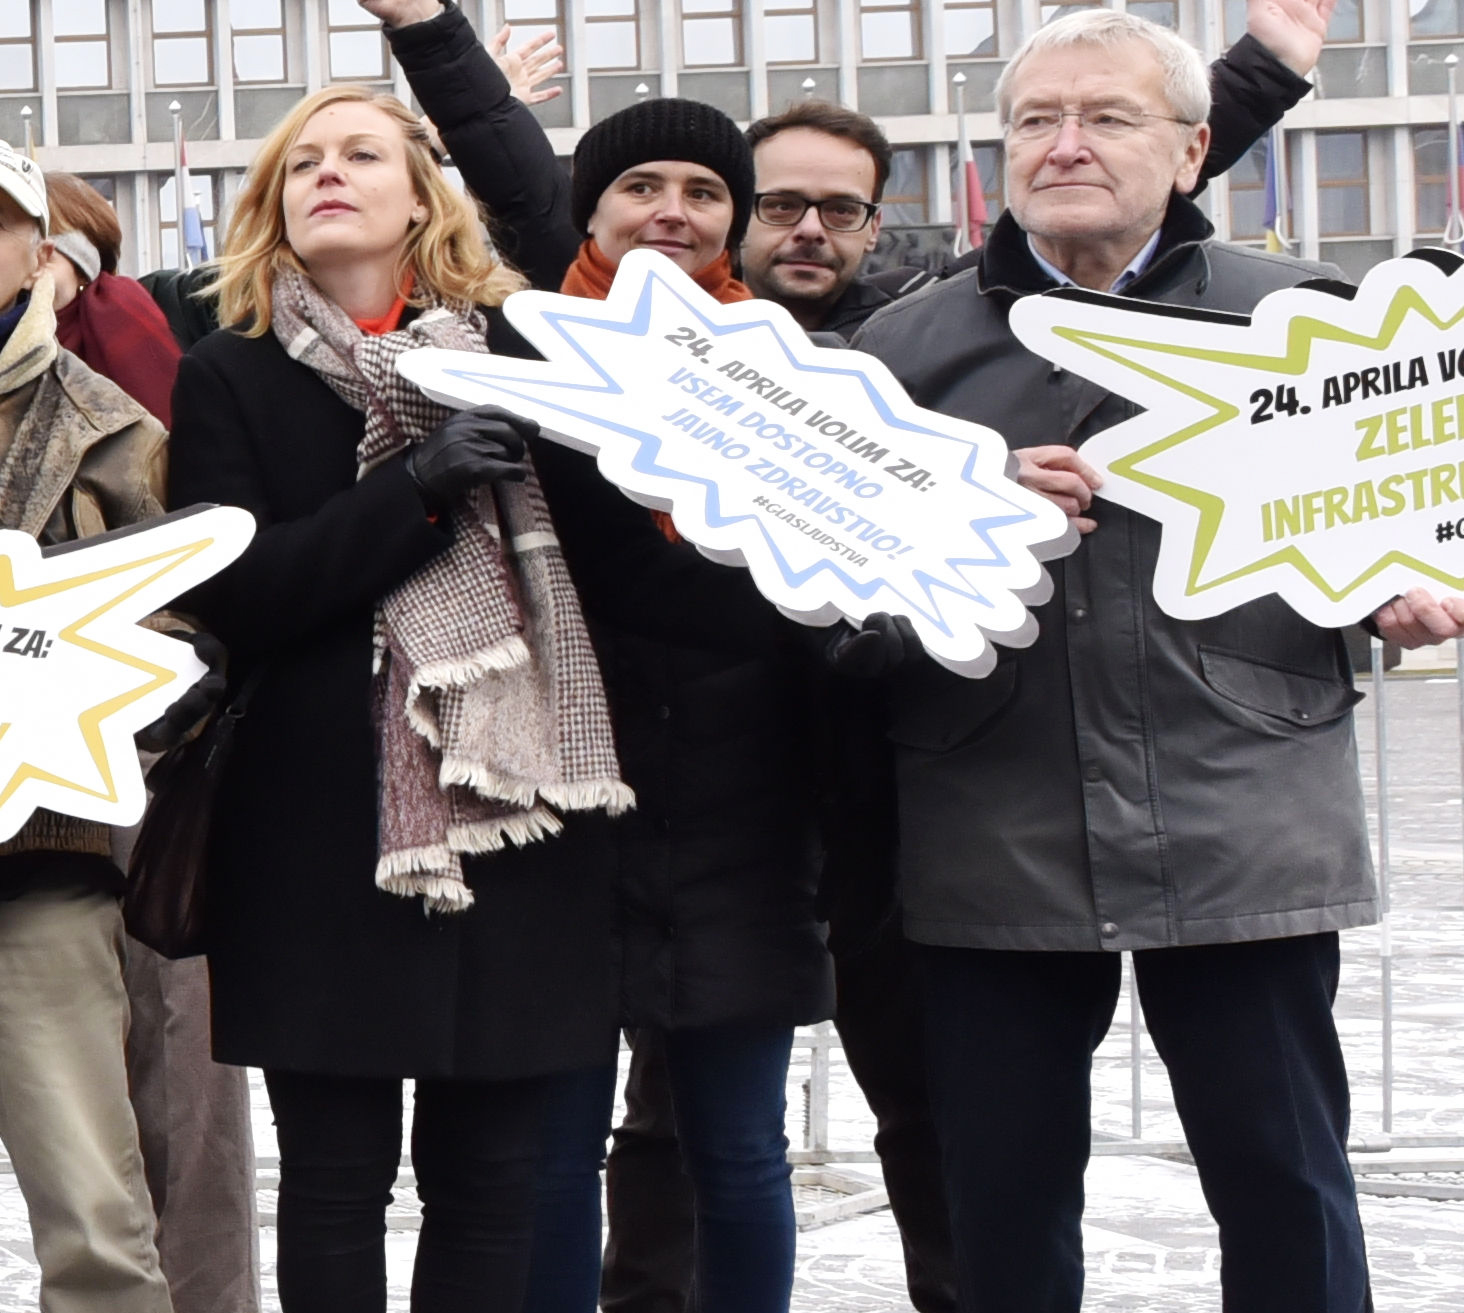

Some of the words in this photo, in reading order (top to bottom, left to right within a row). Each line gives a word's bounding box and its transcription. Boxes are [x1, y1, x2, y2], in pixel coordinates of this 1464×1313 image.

[664, 327, 714, 364] 24.
[716, 360, 808, 416] APRILA
[803, 410, 890, 468] VOLIM
[883, 458, 936, 492] ZA:
[1250, 384, 1311, 425] 24.
[1322, 356, 1429, 409] APRILA
[666, 367, 738, 417] VSEM
[737, 409, 885, 501] DOSTOPNO
[661, 408, 750, 459] JAVNO
[744, 453, 914, 561] ZDRAVSTVO!
[1260, 460, 1464, 543] INFRASTR
[752, 495, 869, 568] #GLASLJUDSTVA
[2, 627, 53, 658] ZA:
